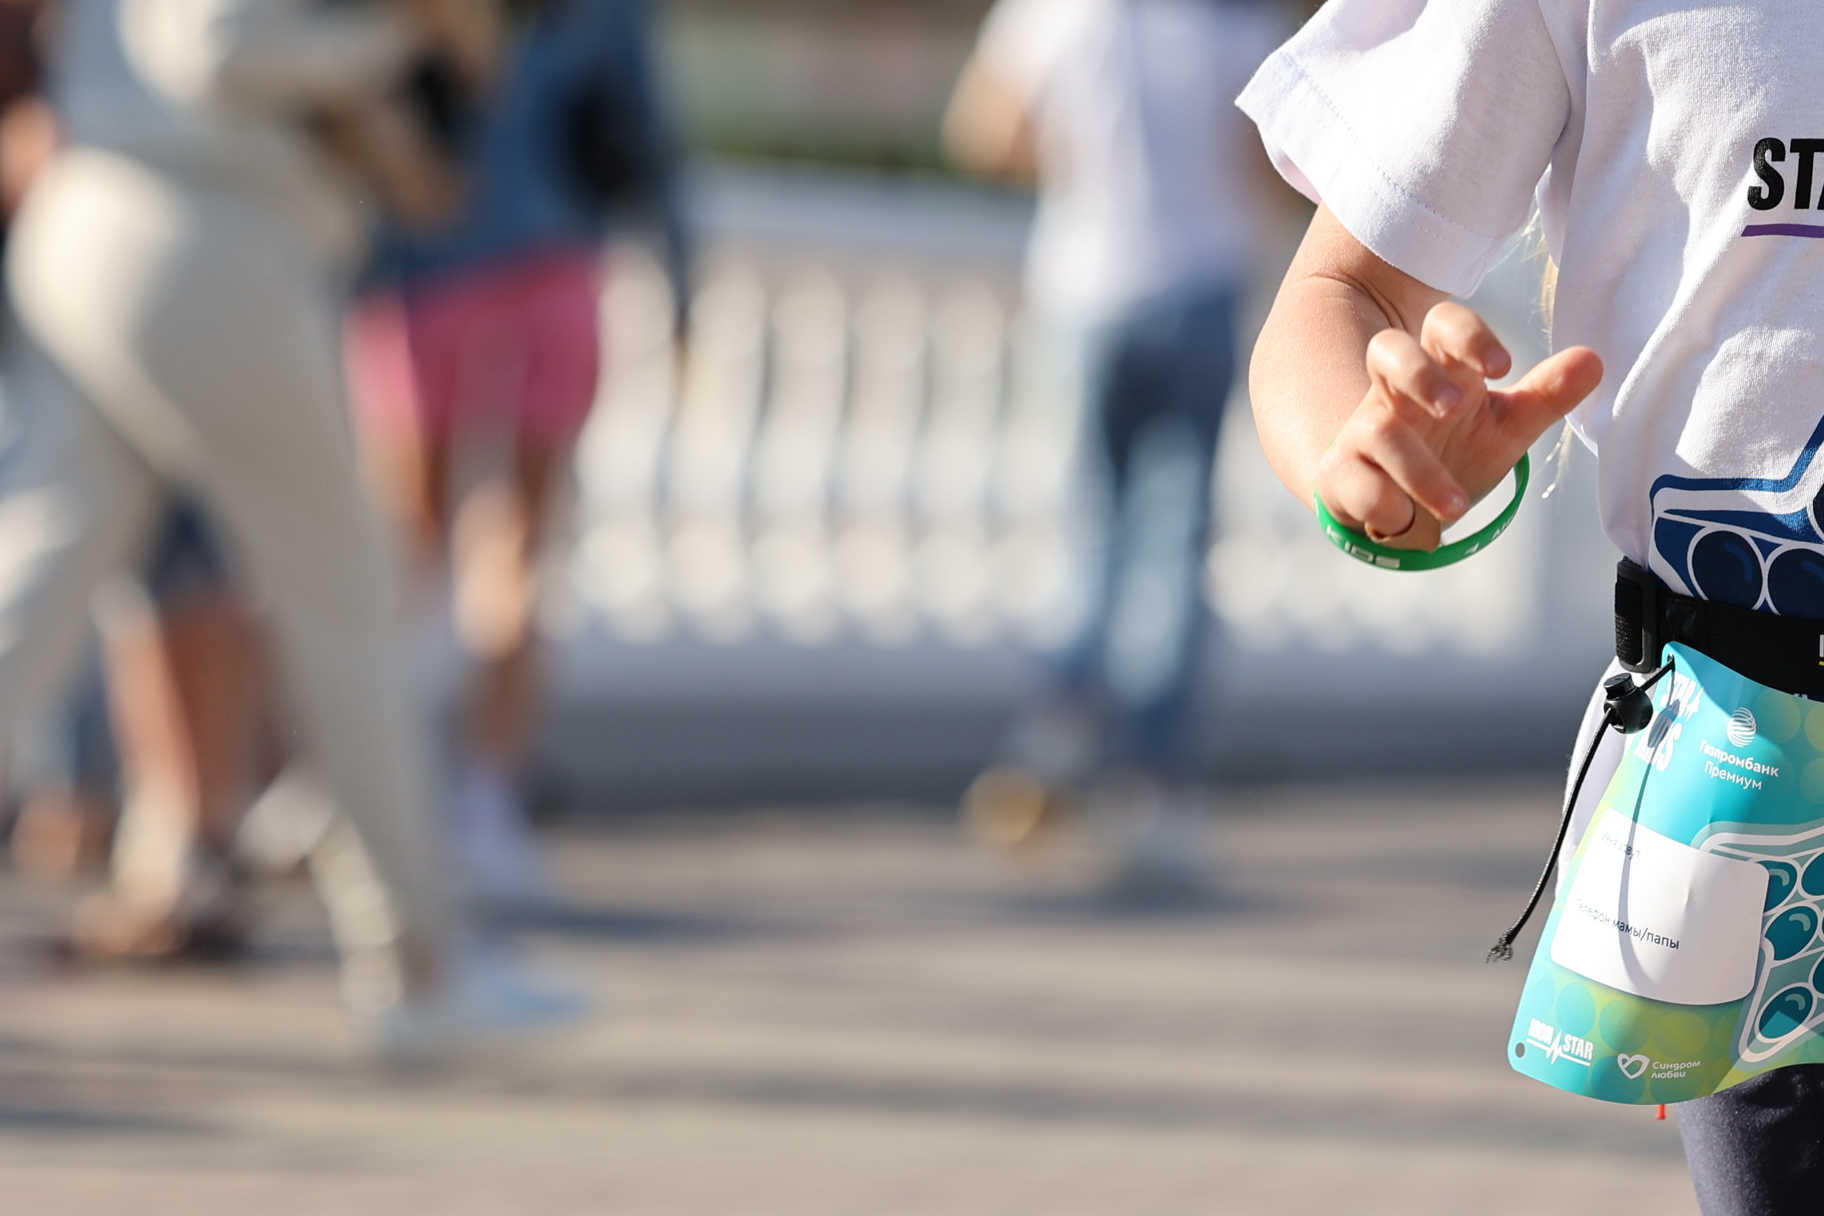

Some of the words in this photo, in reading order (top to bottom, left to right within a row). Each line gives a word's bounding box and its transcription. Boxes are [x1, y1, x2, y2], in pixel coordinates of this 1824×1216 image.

[1699, 739, 1780, 778] Газпромбанк
[1704, 760, 1763, 790] Премиум
[1611, 918, 1680, 950] мамы/папы
[1527, 1017, 1555, 1045] IRON
[1563, 1033, 1594, 1061] STAR
[1651, 1060, 1701, 1071] Синдром
[1651, 1070, 1686, 1079] любви
